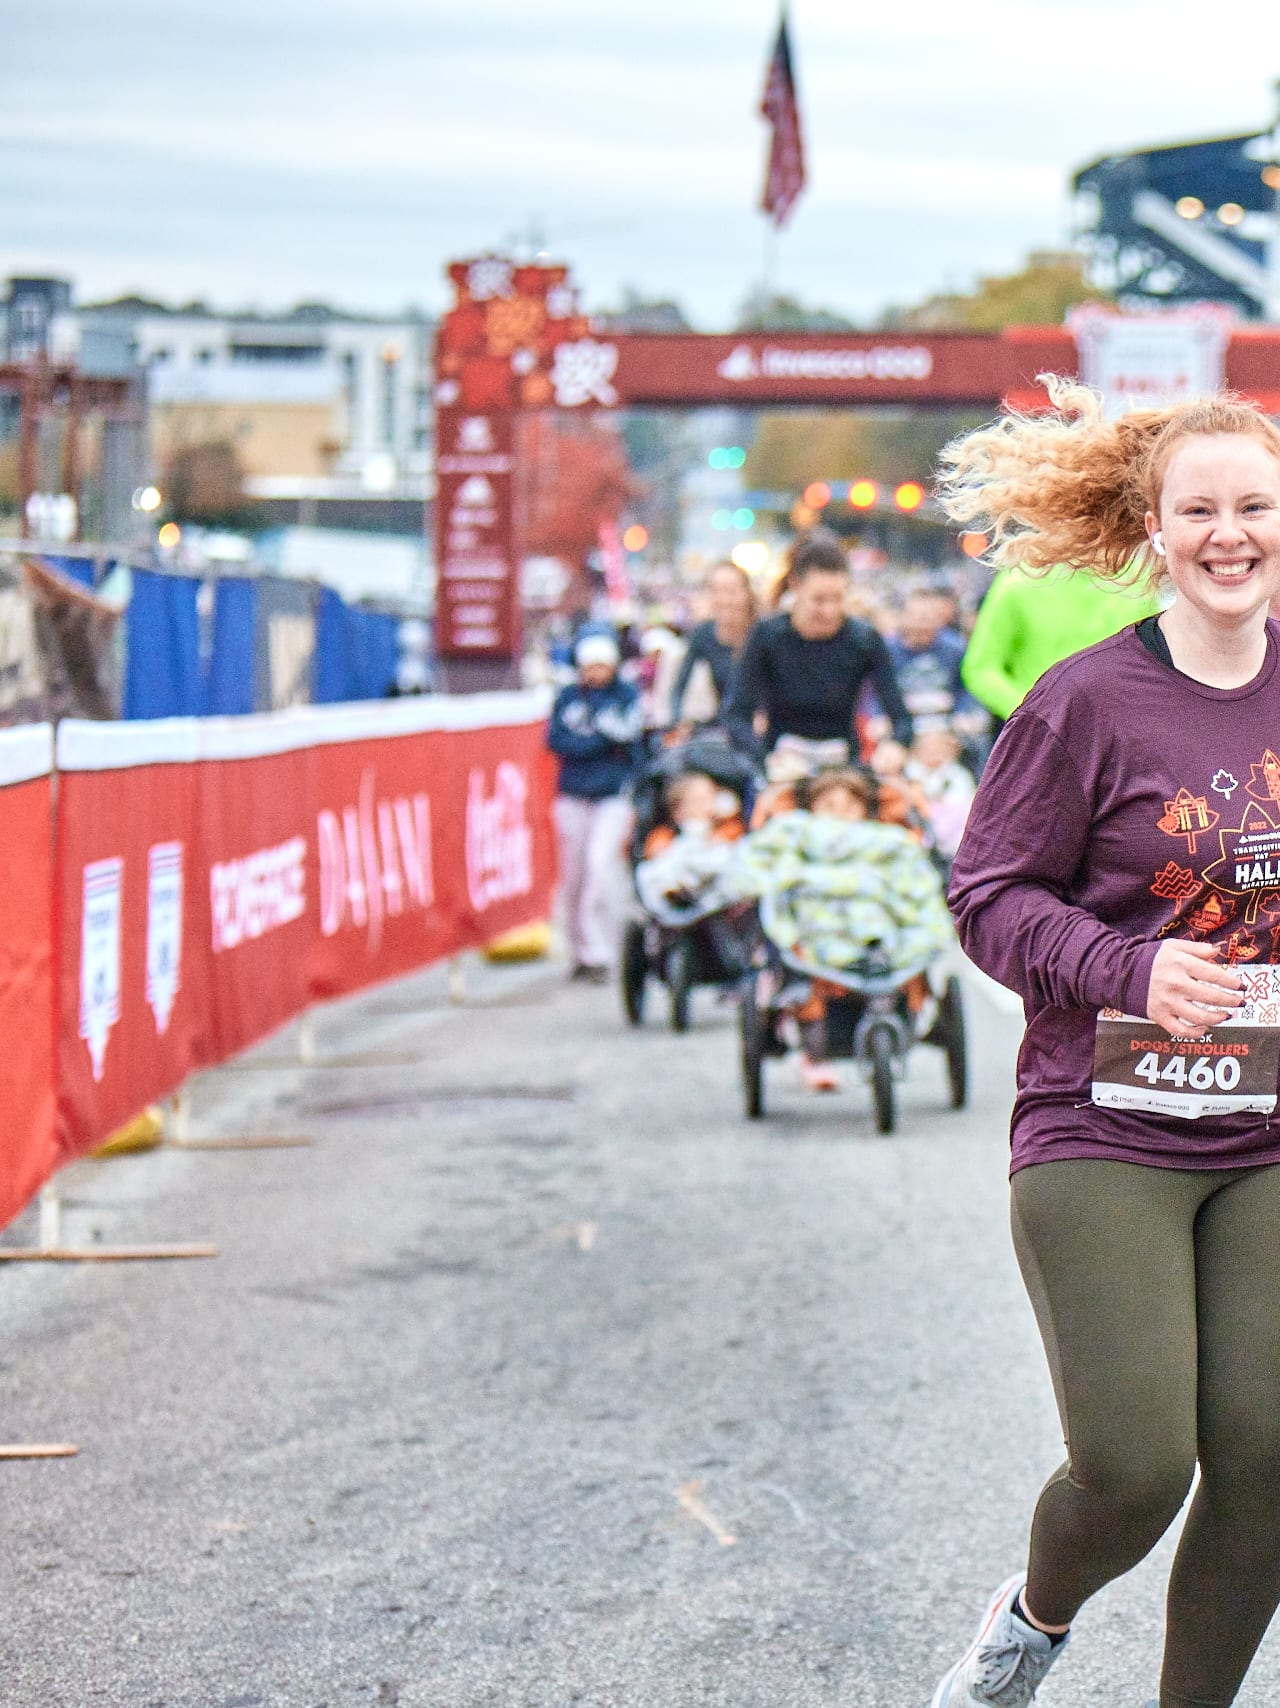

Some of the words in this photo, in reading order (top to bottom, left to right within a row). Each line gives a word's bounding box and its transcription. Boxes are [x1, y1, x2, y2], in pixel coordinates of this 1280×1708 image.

[1248, 821, 1268, 831] 2022
[1254, 852, 1269, 861] DAY
[1241, 879, 1279, 890] MARATHON
[1130, 1039, 1250, 1057] DOGS/STROLLERS
[1134, 1052, 1241, 1091] 4460
